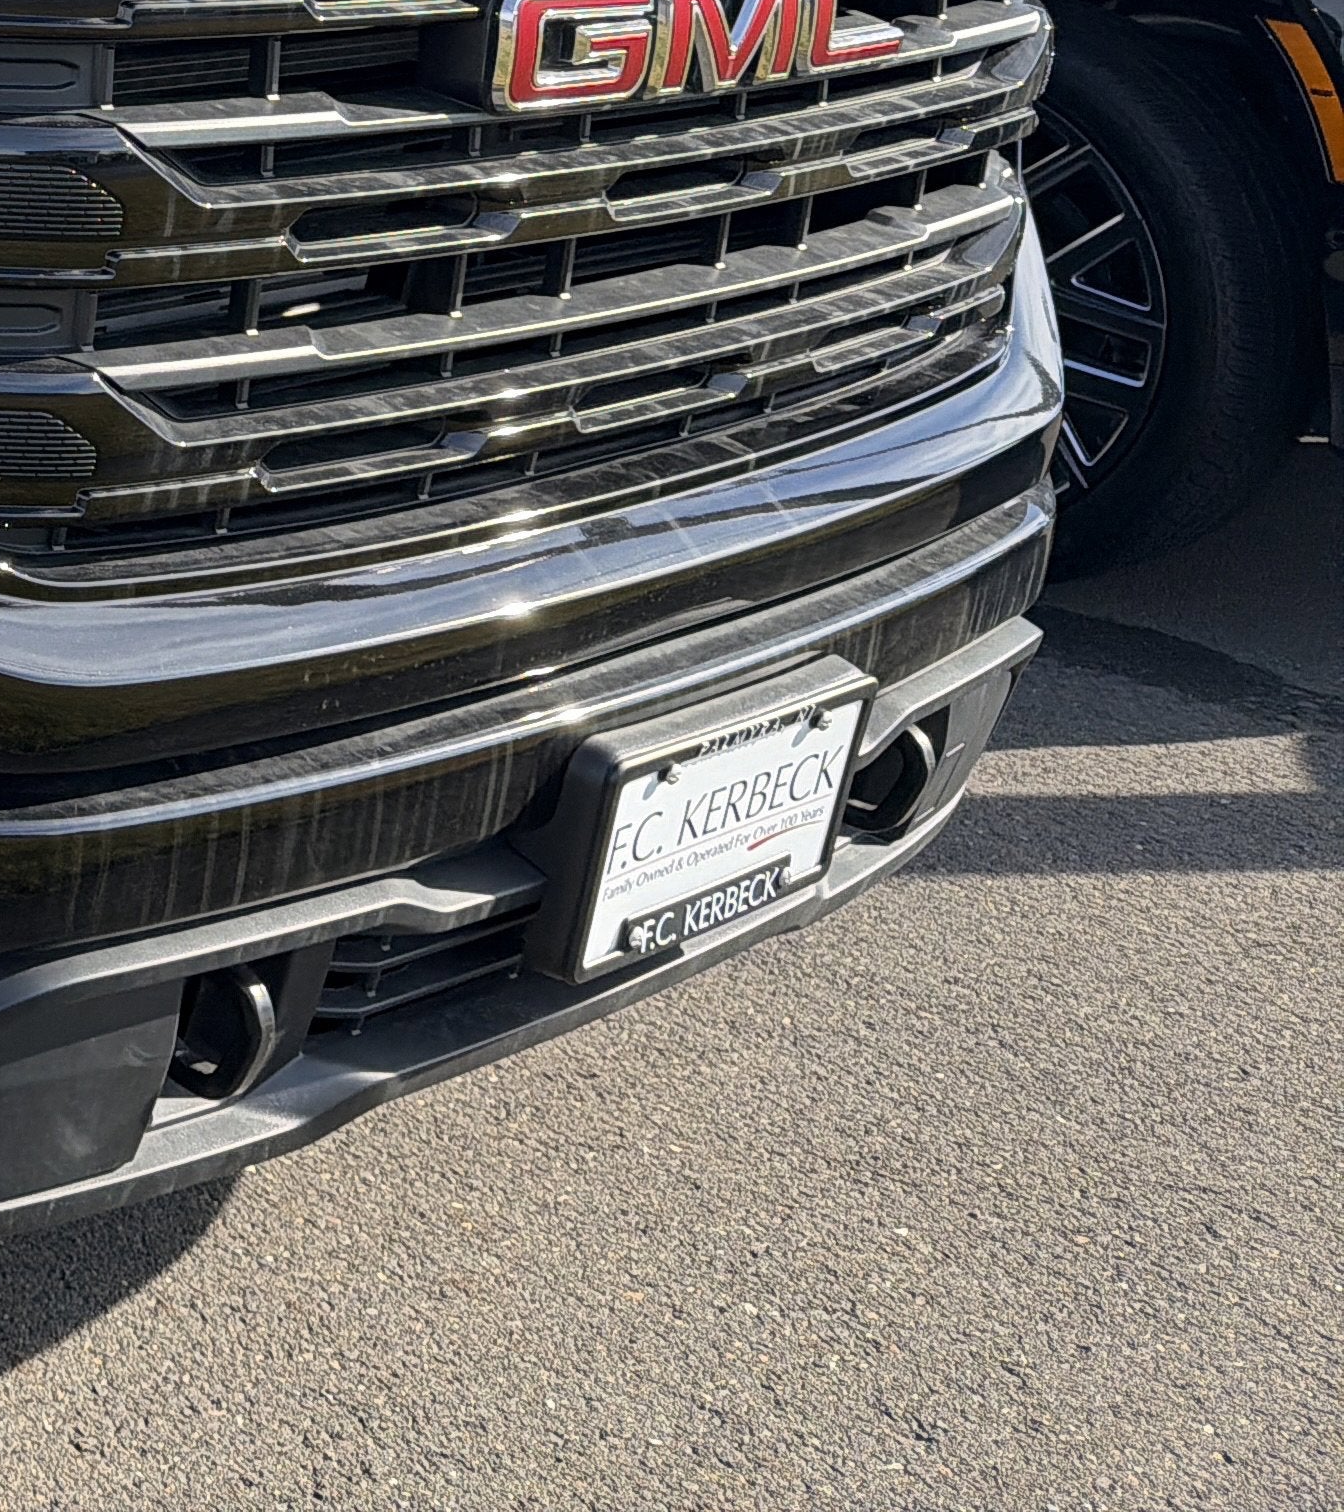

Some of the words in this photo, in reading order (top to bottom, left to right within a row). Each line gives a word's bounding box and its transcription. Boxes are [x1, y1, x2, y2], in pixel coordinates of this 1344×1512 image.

[606, 811, 664, 875] F.C.
[677, 744, 845, 846] KERBECK
[735, 831, 752, 847] For
[752, 822, 778, 840] Over
[639, 911, 677, 954] F.C.
[683, 867, 780, 936] KERBECK
